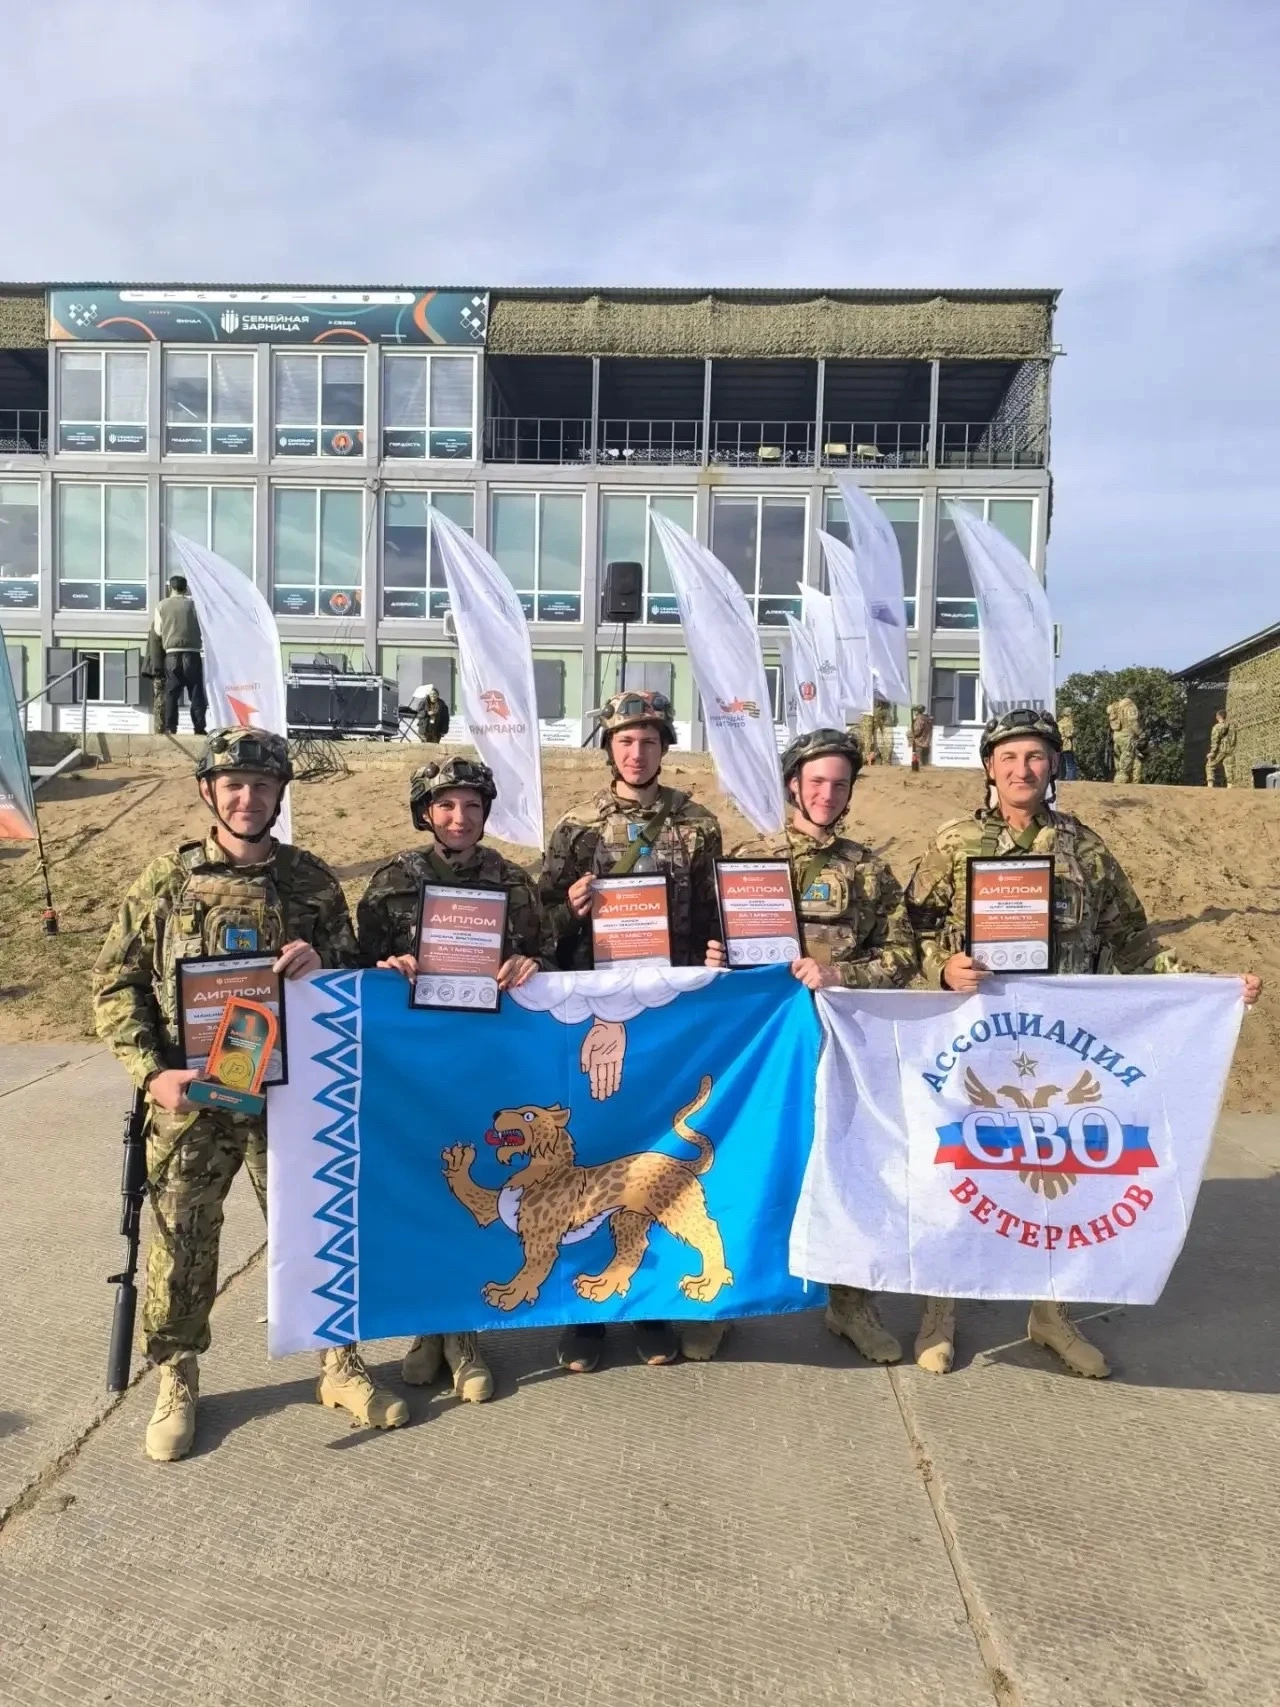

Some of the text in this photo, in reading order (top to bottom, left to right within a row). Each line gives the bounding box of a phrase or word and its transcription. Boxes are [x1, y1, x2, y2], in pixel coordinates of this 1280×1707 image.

[241, 314, 310, 323] СЕМЕЙНАЯ
[241, 322, 301, 332] ЗАРНИЦА
[726, 885, 784, 894] ДИПЛОМ
[978, 886, 1043, 895] ДИПЛОМ
[598, 902, 661, 914] ДИПЛОМ
[430, 914, 497, 927] ДИПЛОМ
[454, 946, 484, 954] МЕСТО
[193, 986, 271, 1002] ДИПЛОМ
[921, 1012, 1146, 1093] АССОЦИАЦИЯ
[961, 1106, 1125, 1168] СВО
[949, 1176, 1154, 1250] ВЕТЕРАНОВ
